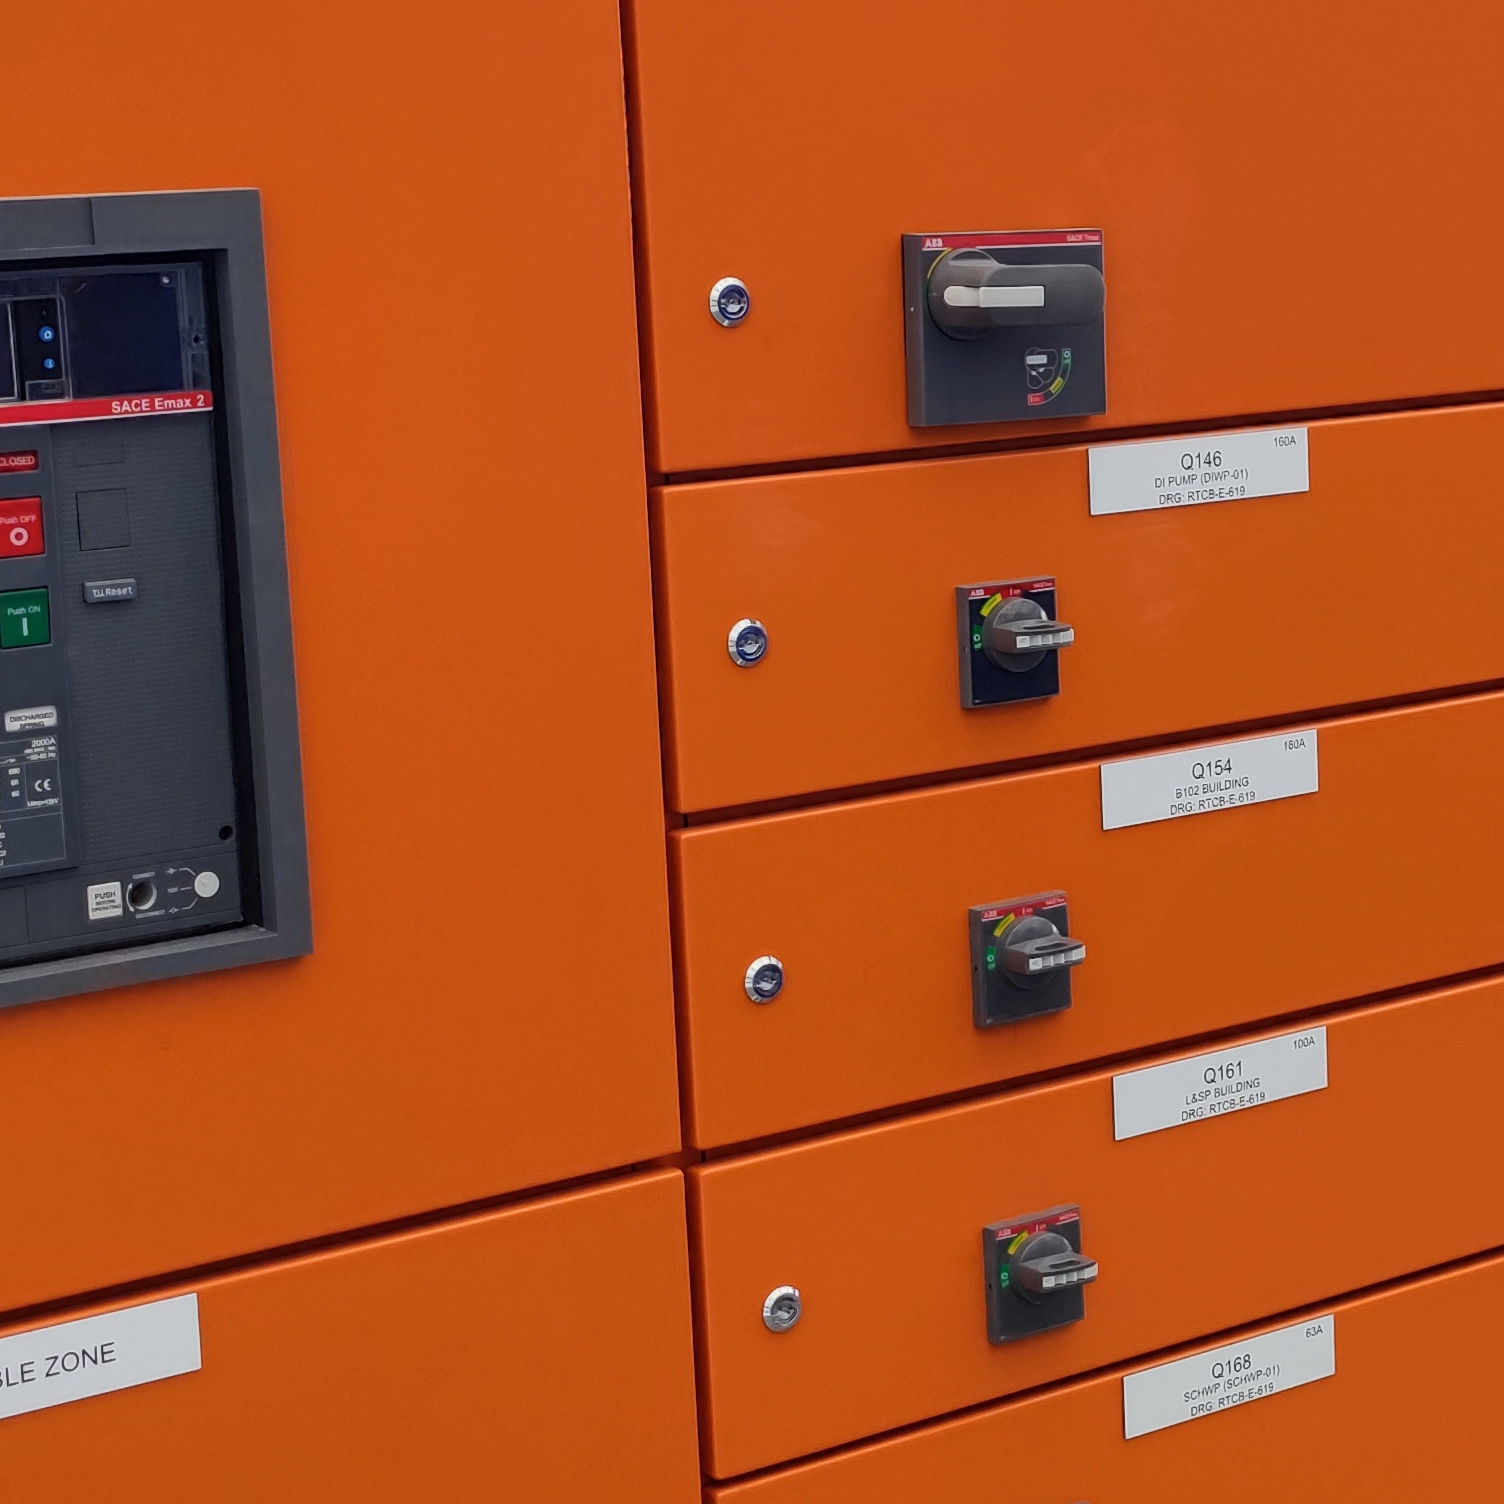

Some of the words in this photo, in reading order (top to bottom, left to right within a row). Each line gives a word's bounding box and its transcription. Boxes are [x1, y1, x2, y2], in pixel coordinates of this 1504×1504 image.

[925, 238, 942, 247] ABB
[111, 400, 150, 415] SACE
[155, 396, 192, 411] Emax
[197, 394, 205, 407] 2
[1274, 436, 1296, 447] 160A
[1181, 451, 1222, 470] Q146
[1155, 477, 1166, 488] DI
[1169, 473, 1198, 487] PUMP
[1159, 493, 1185, 505] DRG:
[1188, 486, 1245, 501] RTCB-E-619
[0, 516, 18, 524] Push
[8, 607, 26, 615] Push
[28, 606, 40, 614] ON
[10, 712, 54, 722] DISCHARGED
[32, 738, 56, 746] 2000A
[1284, 738, 1306, 751] 160A
[1192, 758, 1232, 780] Q154
[1176, 785, 1199, 799] B102
[1203, 777, 1249, 794] BUILDING
[1170, 802, 1196, 815] DRG:
[1198, 791, 1255, 810] RTCB-E-619
[95, 891, 116, 899] PUSH
[1293, 1036, 1315, 1050] 100A
[1204, 1061, 1243, 1084] Q161
[1186, 1090, 1211, 1105] L&SP
[1214, 1078, 1260, 1099] BUILDING
[1182, 1108, 1207, 1121] DRG:
[1209, 1092, 1265, 1114] RTCB-E-619
[1305, 1325, 1323, 1338] 63A
[44, 1341, 117, 1378] ZONE
[1212, 1354, 1252, 1378] Q168
[1184, 1381, 1220, 1402] SCHWP
[1190, 1402, 1215, 1417] DRG:
[1218, 1382, 1274, 1408] RTCB-E-619
